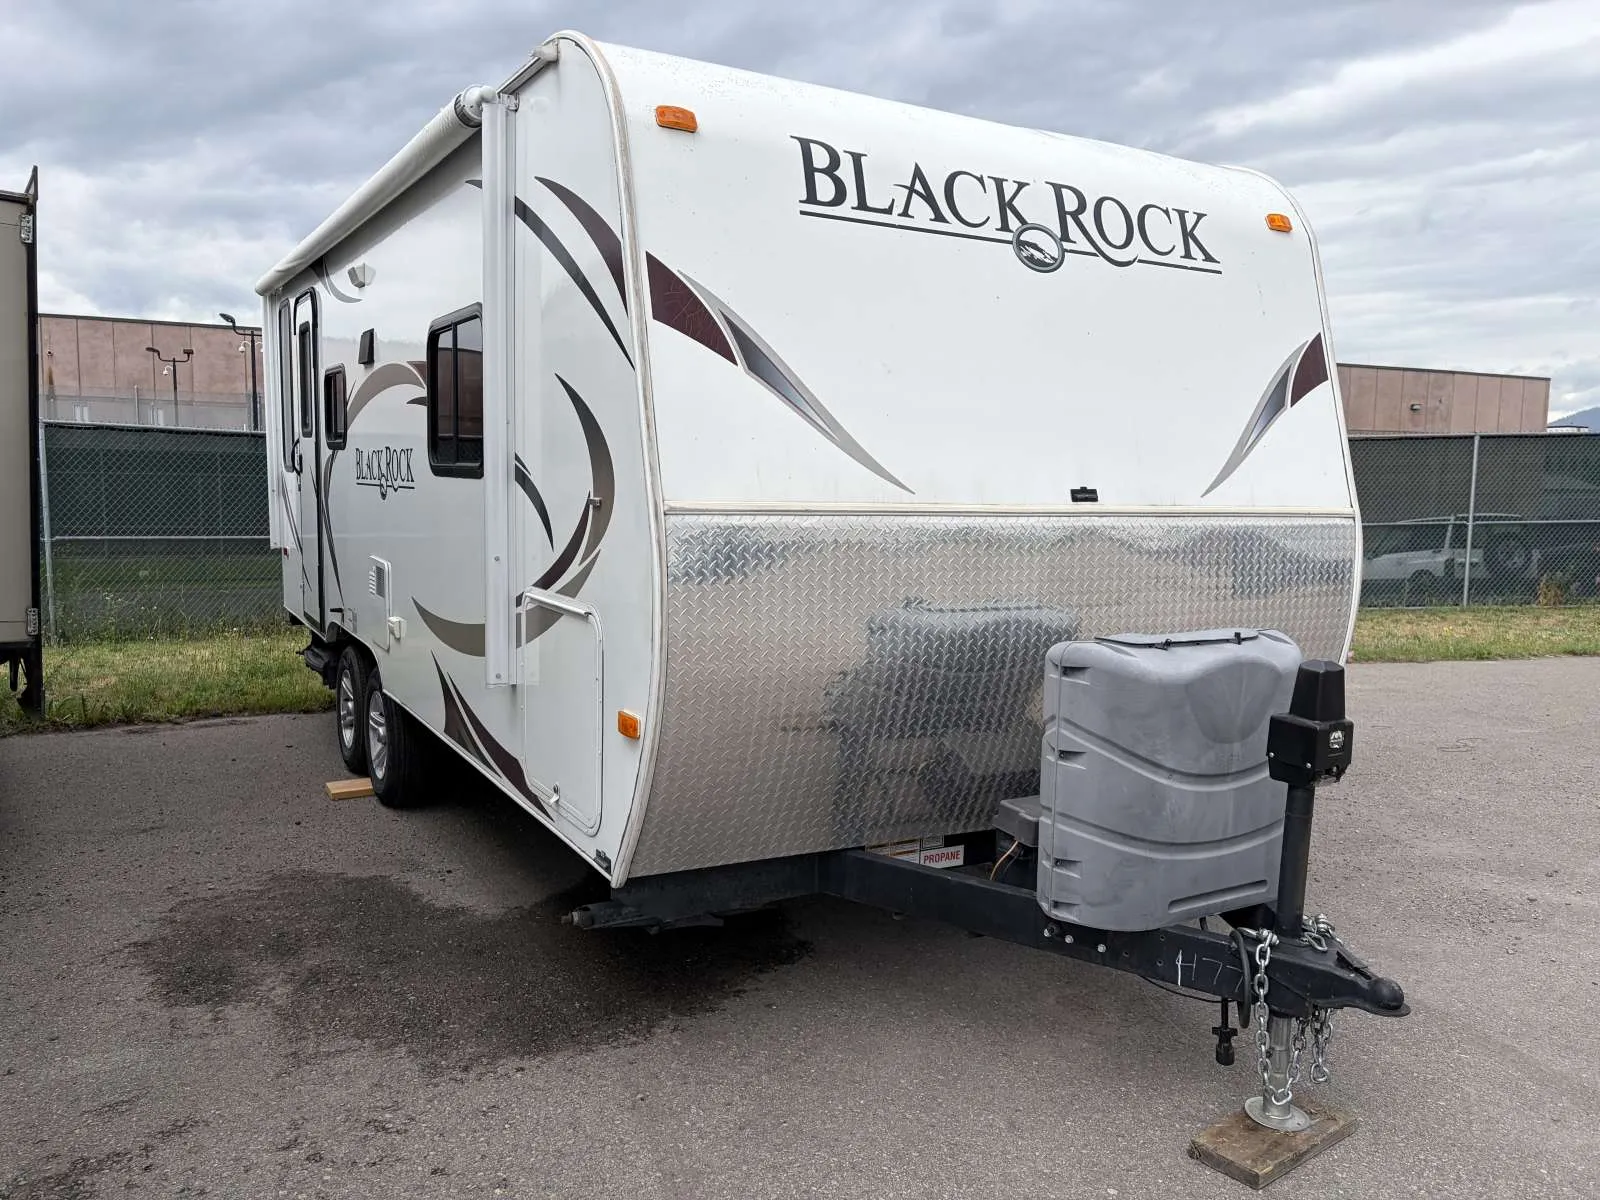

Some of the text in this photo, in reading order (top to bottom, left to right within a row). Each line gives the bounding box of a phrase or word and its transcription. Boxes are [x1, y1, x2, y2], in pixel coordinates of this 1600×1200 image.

[790, 136, 1221, 267] BLACK ROCK
[355, 446, 415, 492] BLACK ROCK
[923, 850, 961, 865] PROPANE
